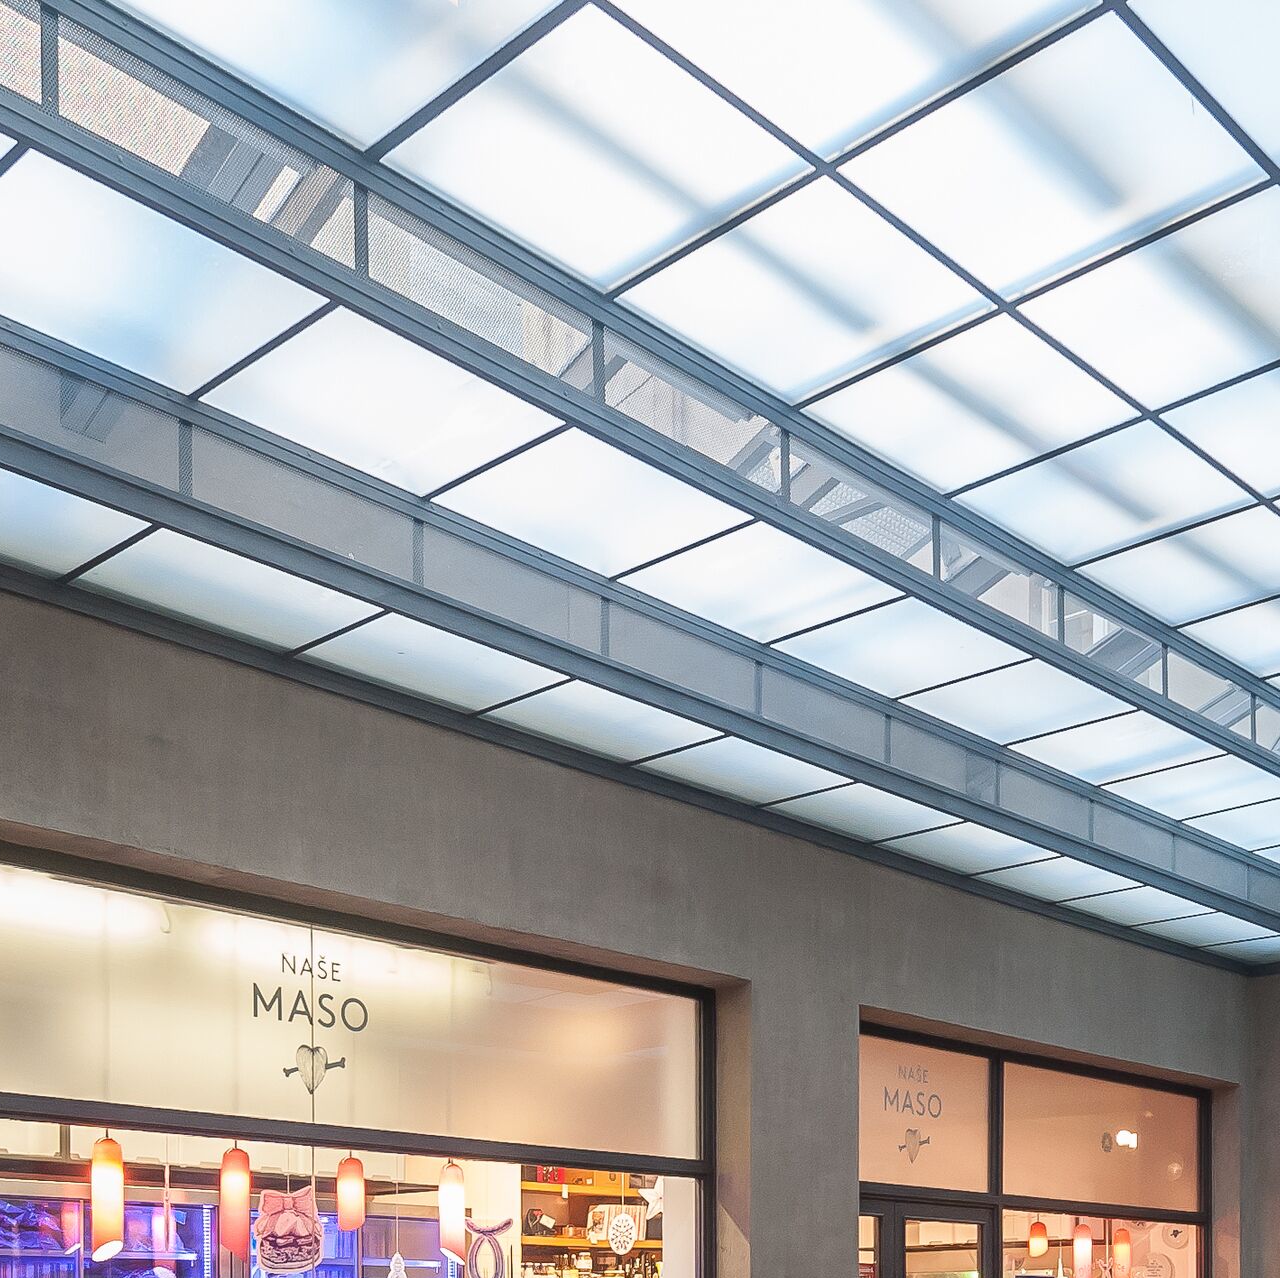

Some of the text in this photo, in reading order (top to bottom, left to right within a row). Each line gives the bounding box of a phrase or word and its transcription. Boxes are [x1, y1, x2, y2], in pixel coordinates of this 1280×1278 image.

[281, 953, 341, 982] NAŠE
[252, 982, 368, 1032] MASO
[897, 1064, 929, 1084] NAŠE
[883, 1086, 942, 1119] MASO
